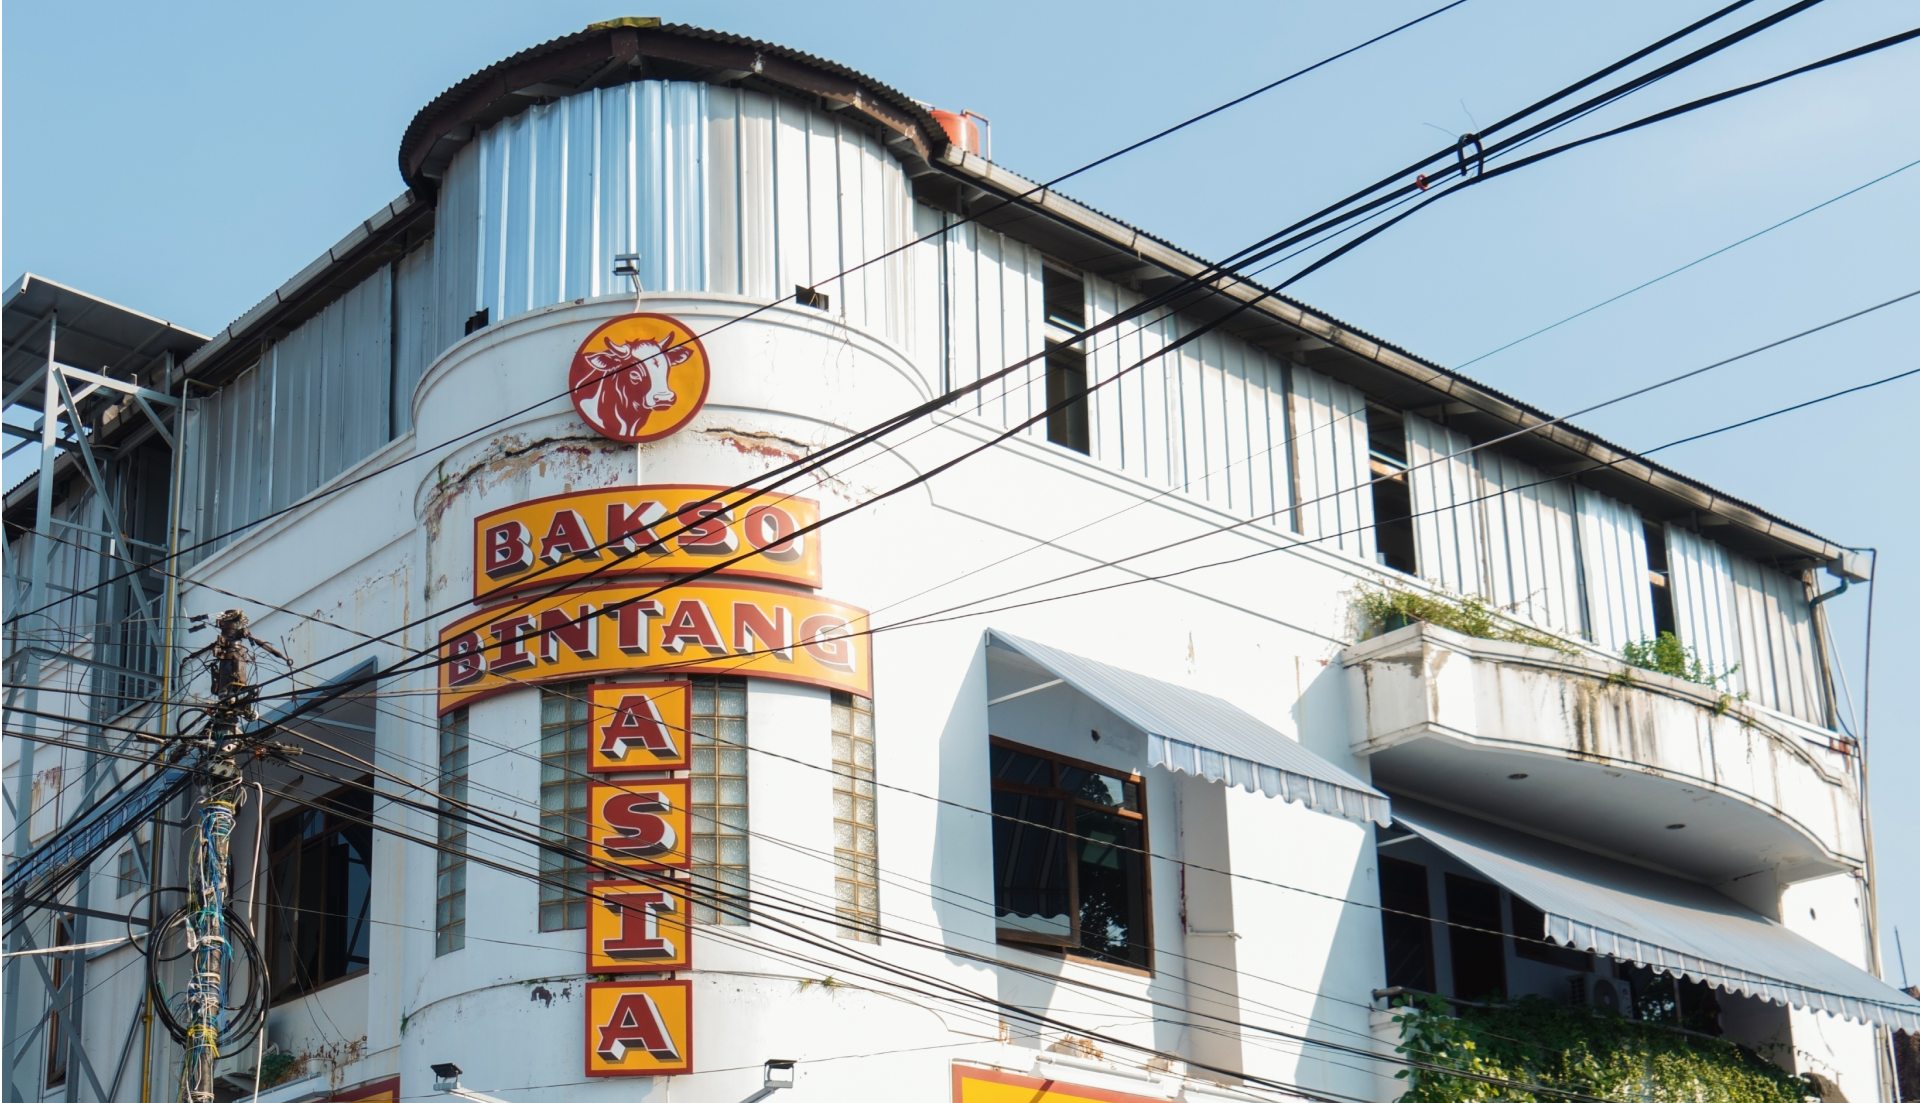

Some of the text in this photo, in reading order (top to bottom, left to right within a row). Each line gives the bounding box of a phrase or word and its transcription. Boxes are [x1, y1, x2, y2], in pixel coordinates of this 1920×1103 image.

[484, 501, 802, 579] BAKSO
[448, 600, 856, 688] BINTANG
[596, 694, 682, 1062] ASIA
